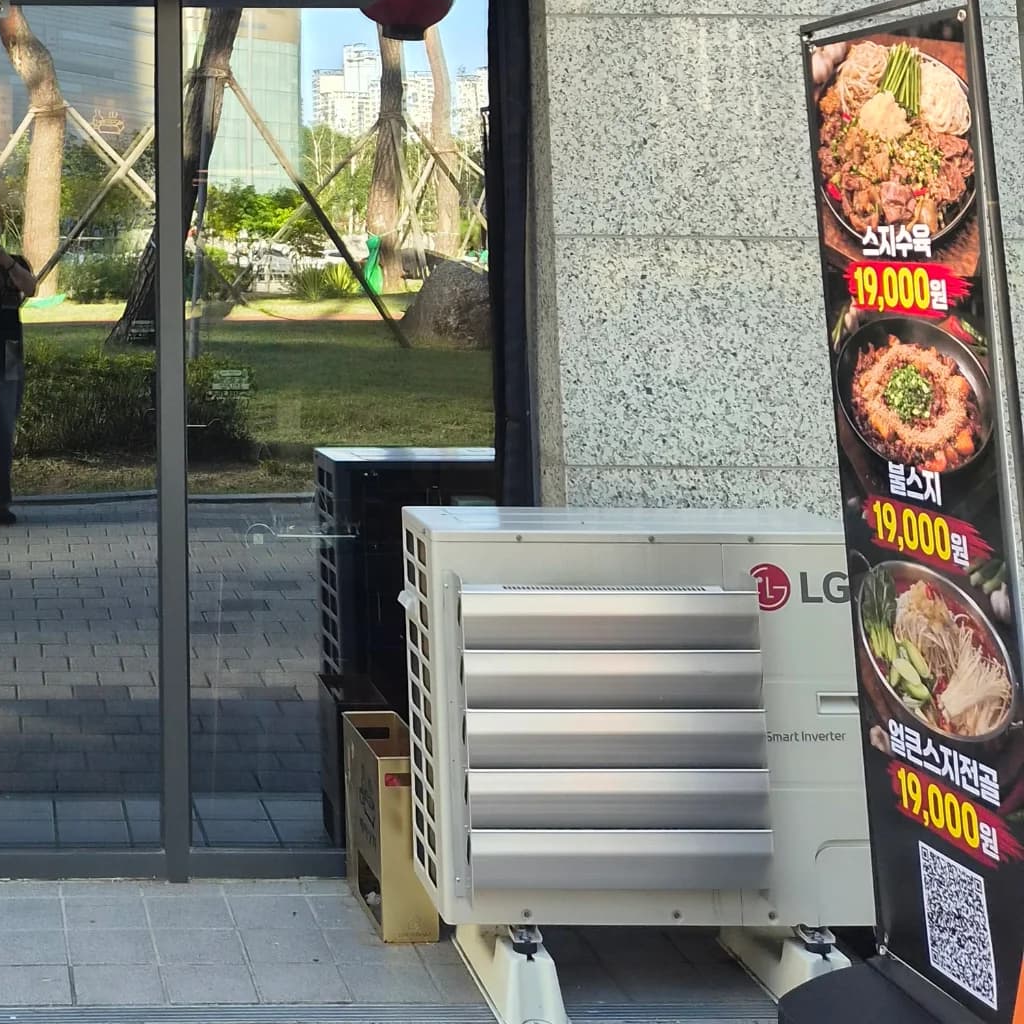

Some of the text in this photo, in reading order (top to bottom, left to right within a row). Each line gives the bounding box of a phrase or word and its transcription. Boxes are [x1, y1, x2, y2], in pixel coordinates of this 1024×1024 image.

[862, 223, 932, 258] 스지수육
[854, 266, 948, 313] 19,000원
[888, 460, 942, 506] 불스지
[872, 500, 970, 568] 19,000원
[799, 571, 852, 604] LG
[767, 730, 846, 742] Smart Inverter
[888, 718, 1001, 807] 얼큰스지전골
[897, 767, 1001, 861] 19,000원
